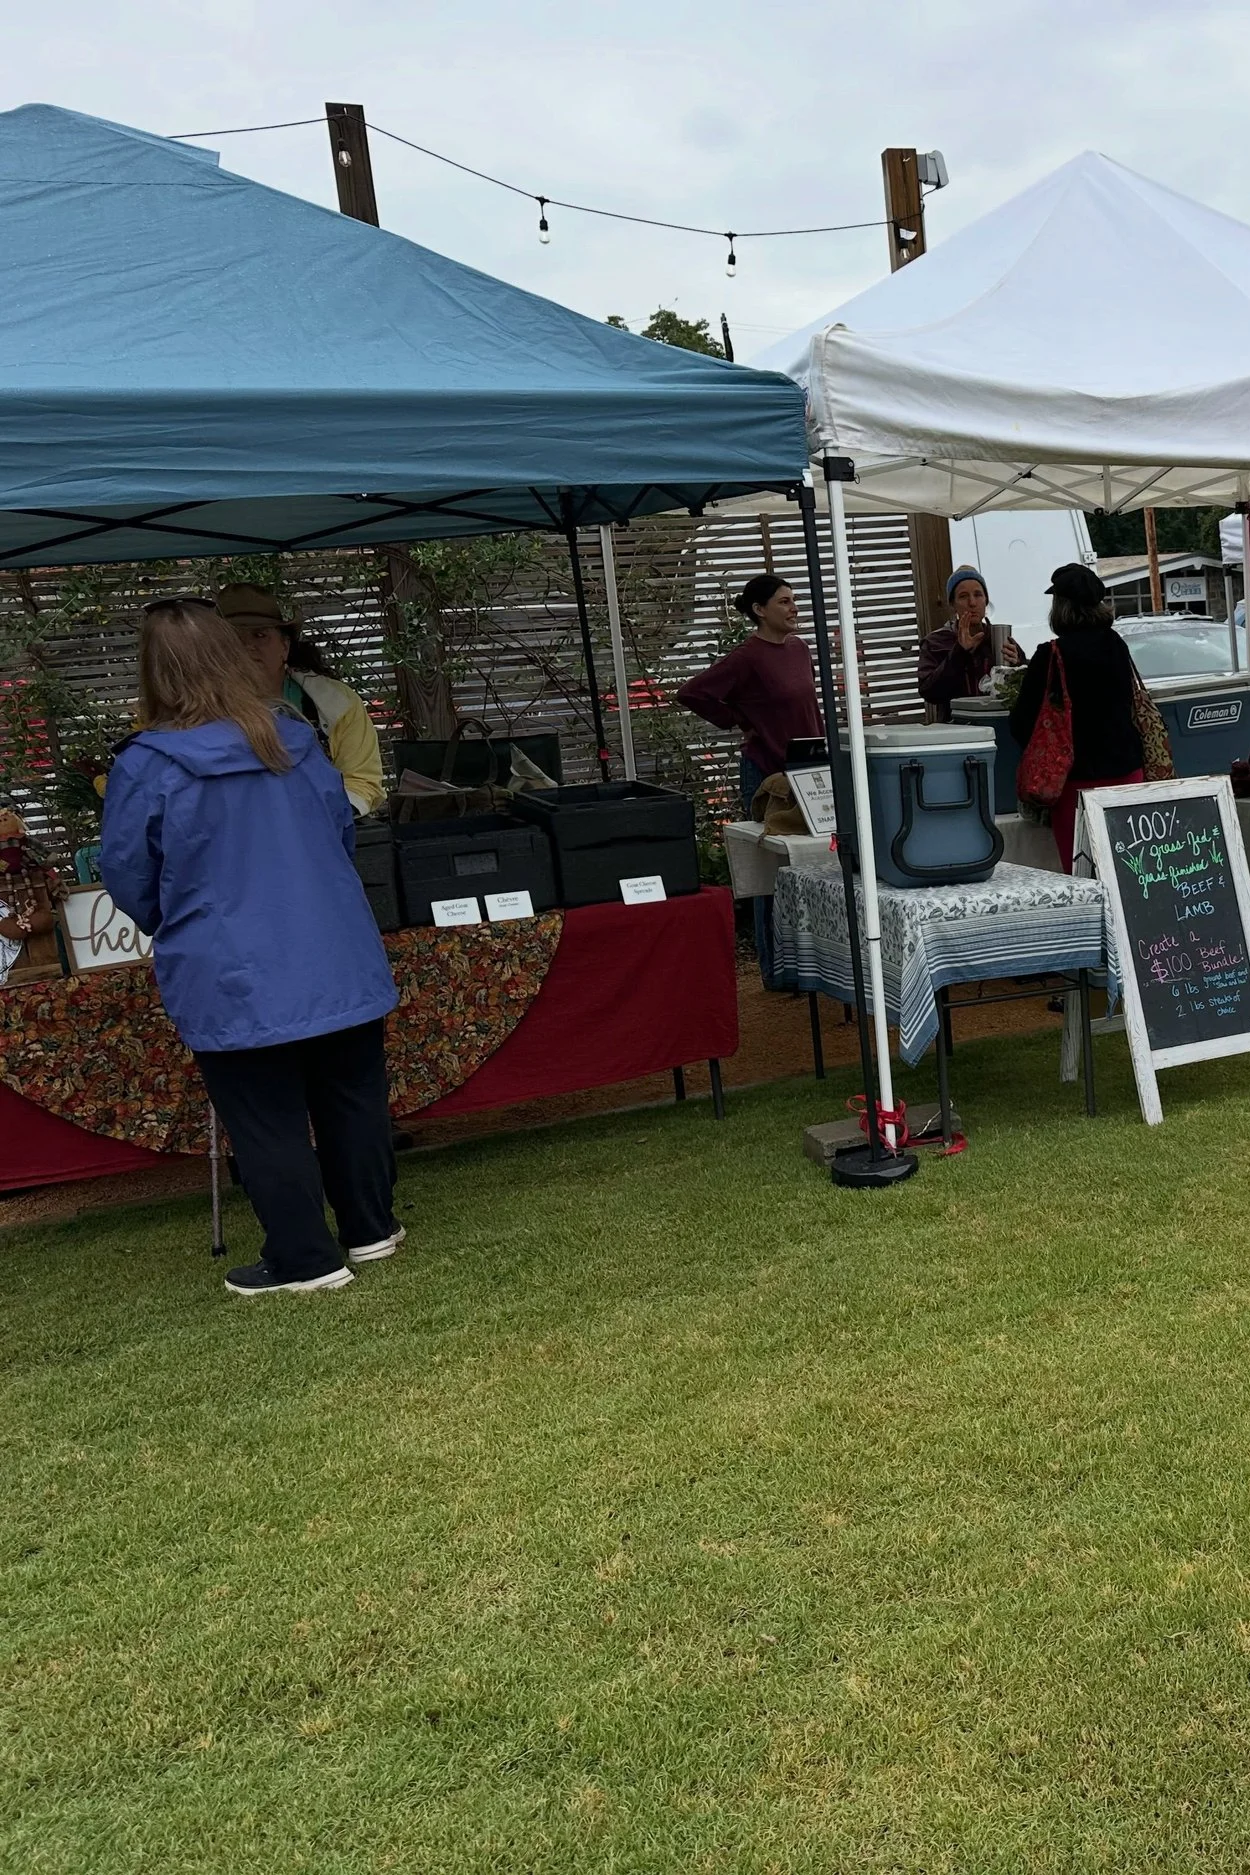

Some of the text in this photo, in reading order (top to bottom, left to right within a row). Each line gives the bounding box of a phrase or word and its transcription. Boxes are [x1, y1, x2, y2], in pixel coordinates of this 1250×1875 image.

[1194, 708, 1229, 721] Coleman
[1127, 806, 1180, 850] 100%
[1176, 877, 1214, 899] BEEF
[1174, 901, 1215, 921] LAMB
[1138, 931, 1200, 960] Create a
[1150, 939, 1226, 983] $100 Beef
[1171, 984, 1180, 996] 6
[1185, 983, 1200, 995] lbs
[1176, 1005, 1187, 1017] 2
[1190, 1001, 1205, 1011] lbs
[1233, 989, 1241, 1002] of
